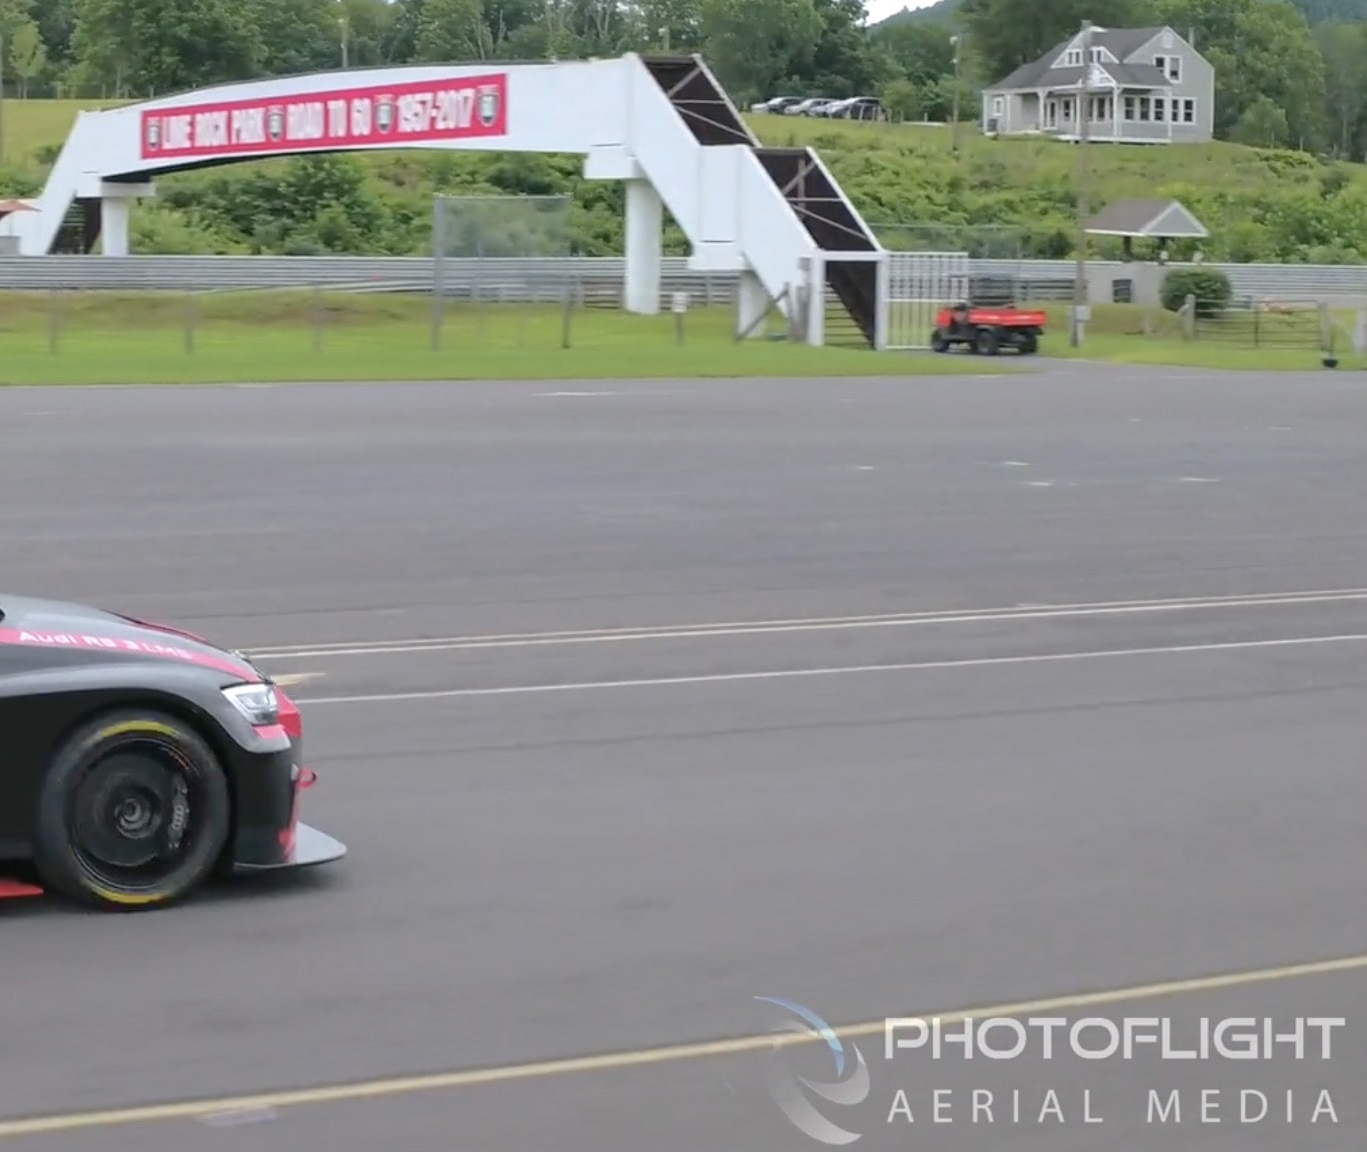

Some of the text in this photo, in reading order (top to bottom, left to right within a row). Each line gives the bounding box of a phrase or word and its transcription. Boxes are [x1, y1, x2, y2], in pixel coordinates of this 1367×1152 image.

[162, 115, 192, 149] LIME
[194, 110, 229, 147] ROCK
[230, 107, 266, 144] PARK
[286, 102, 324, 140] ROAD
[327, 99, 348, 137] TO
[397, 88, 476, 132] 1957-2017
[20, 631, 78, 644] Audi
[82, 635, 117, 648] RS
